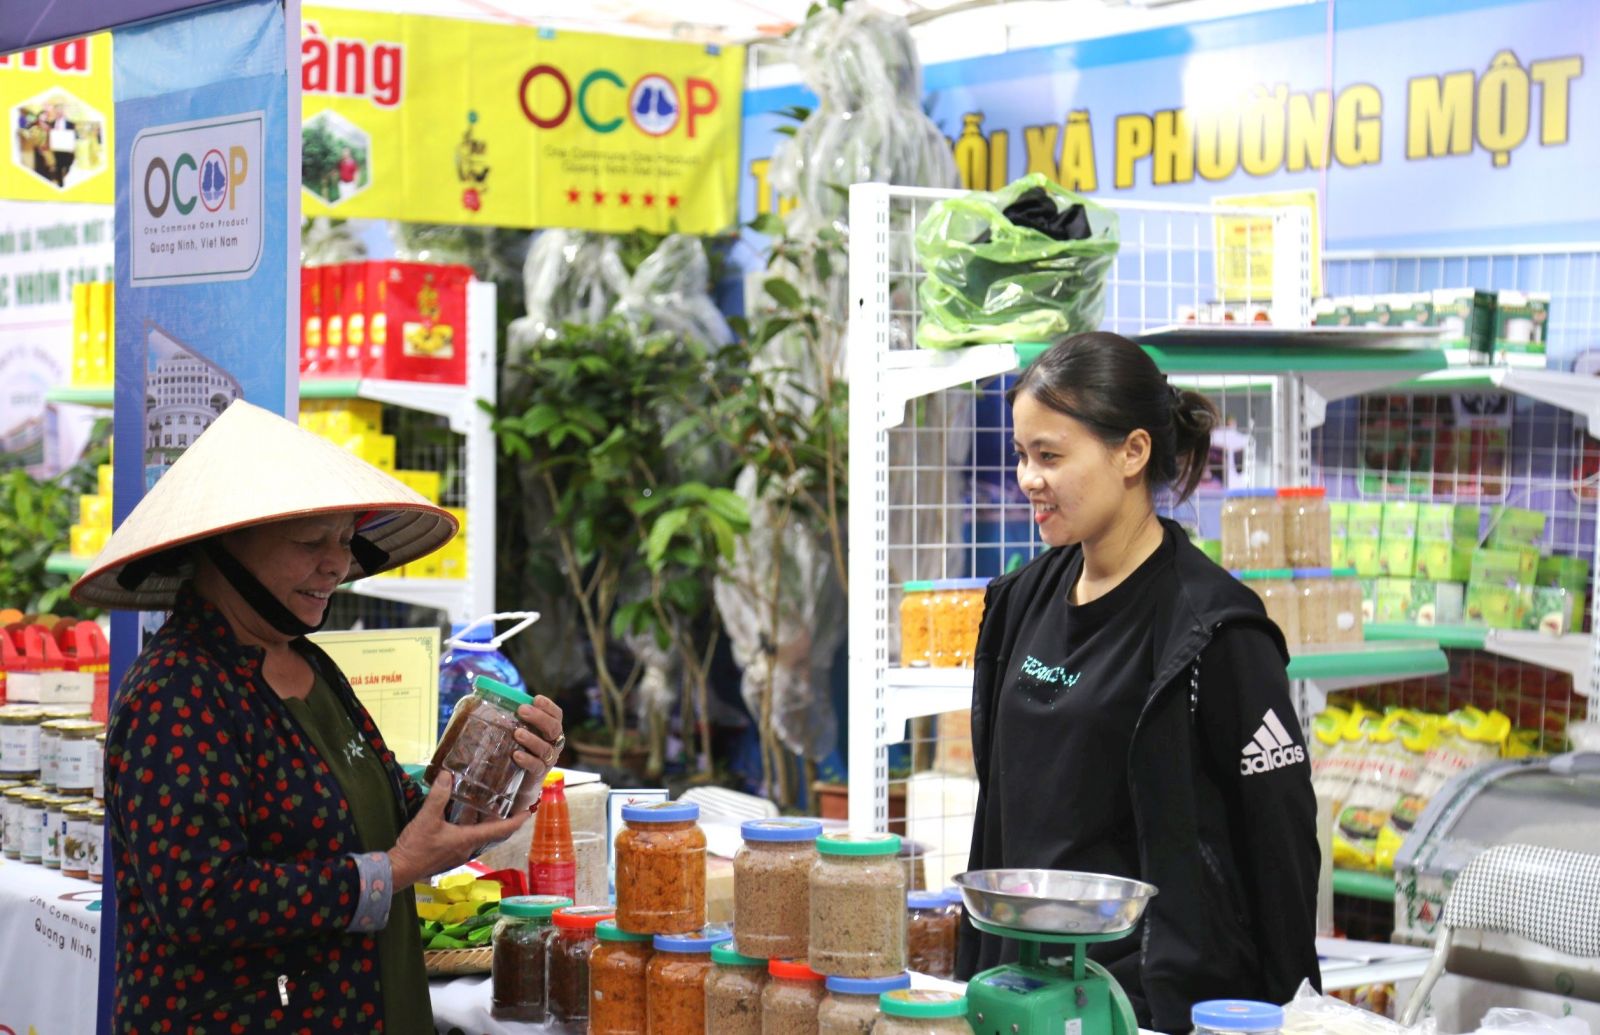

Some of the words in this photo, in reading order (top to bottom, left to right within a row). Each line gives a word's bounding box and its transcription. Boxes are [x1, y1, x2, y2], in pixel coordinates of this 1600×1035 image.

[518, 64, 720, 139] OCOP
[946, 112, 1009, 191] ỖI
[1025, 110, 1098, 192] XÃ
[1406, 49, 1584, 167] MỘT
[144, 145, 249, 218] OCOP
[144, 226, 158, 235] One
[161, 223, 196, 234] Commune
[200, 221, 214, 229] One
[218, 217, 249, 227] Product
[150, 242, 175, 254] Quang
[178, 238, 198, 250] Ninh,
[201, 237, 217, 249] Viet
[220, 236, 238, 247] Nam
[1240, 745, 1305, 776] adidas
[35, 918, 65, 949] Quang
[49, 905, 97, 935] Commune
